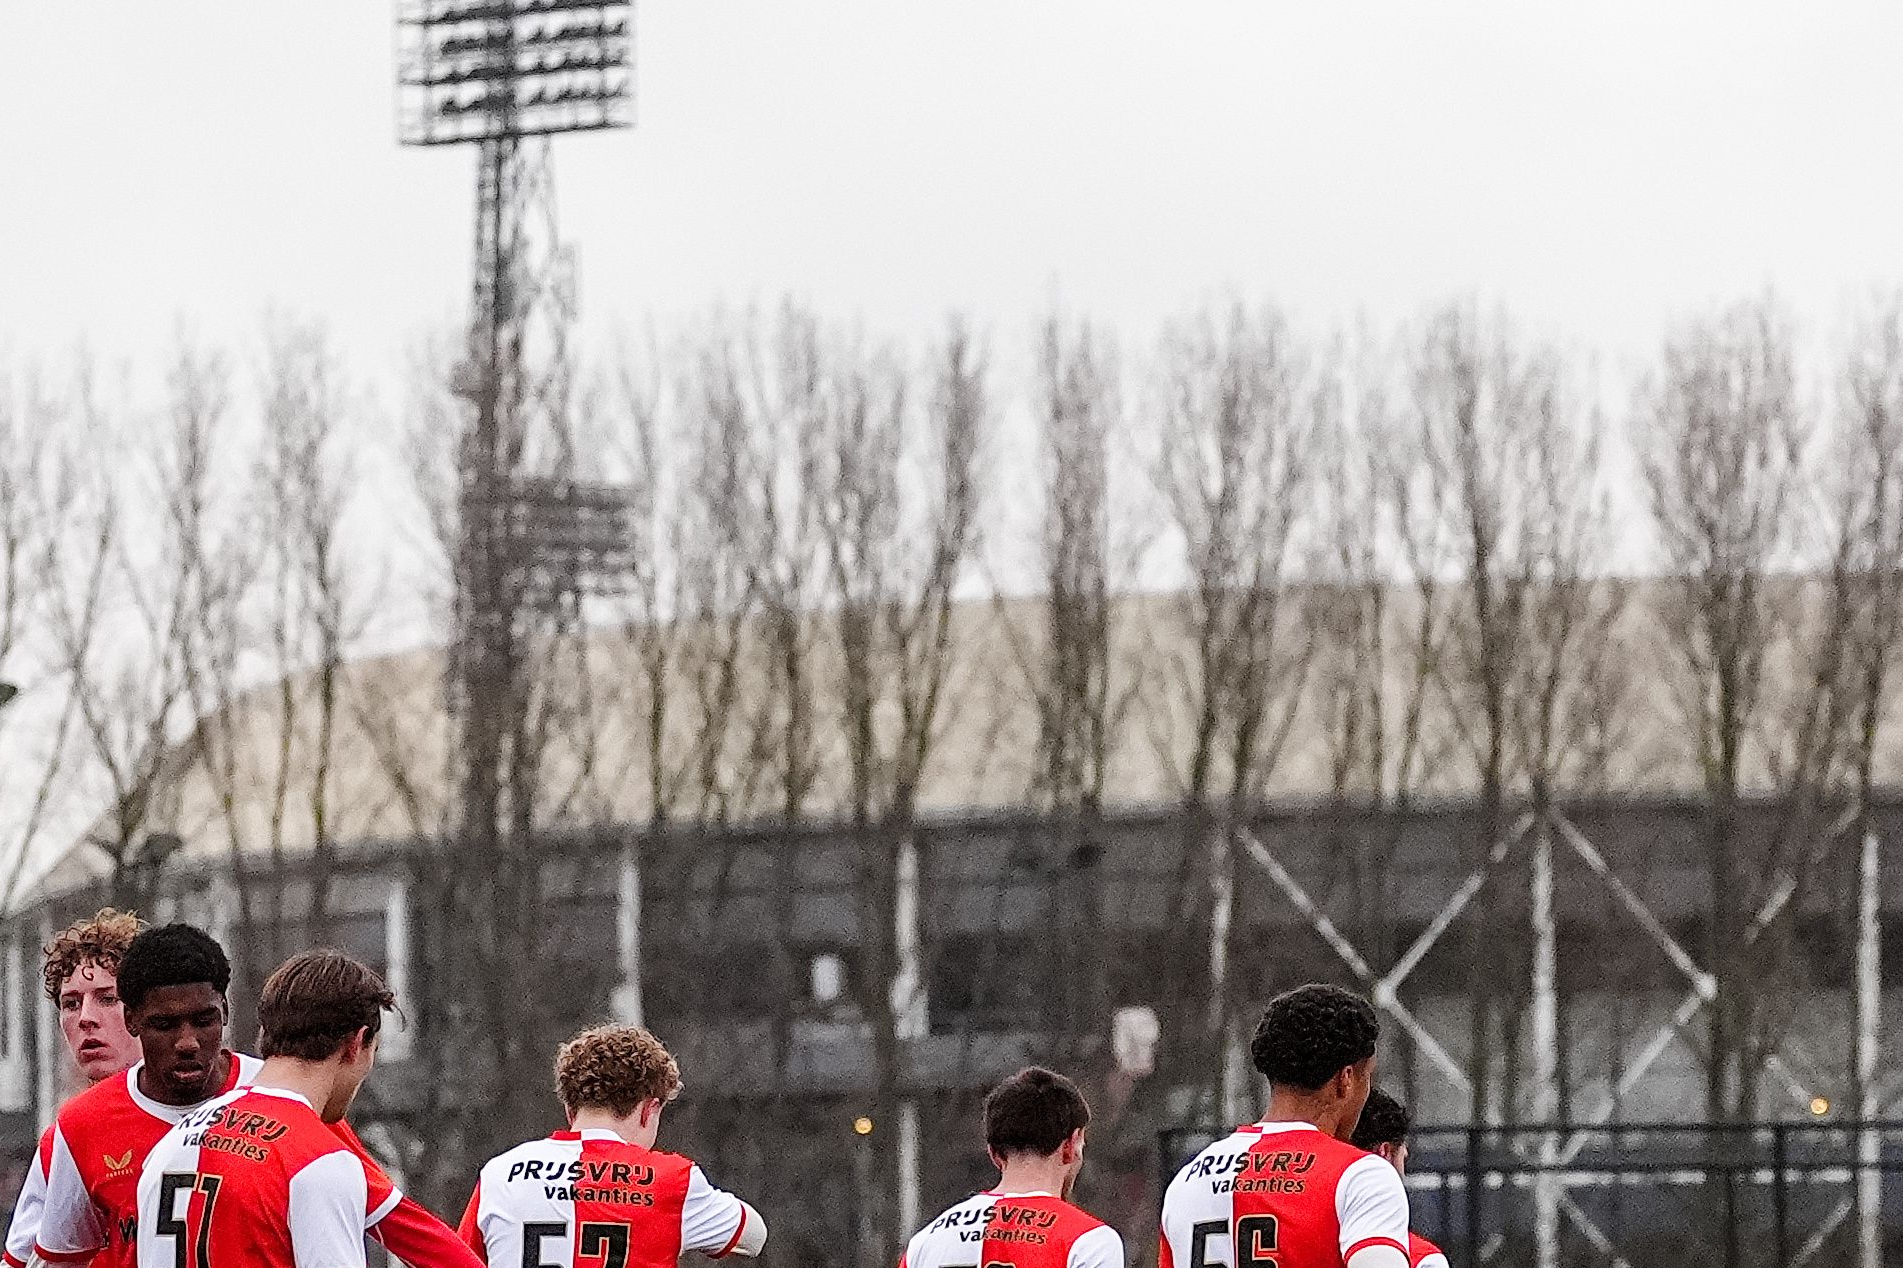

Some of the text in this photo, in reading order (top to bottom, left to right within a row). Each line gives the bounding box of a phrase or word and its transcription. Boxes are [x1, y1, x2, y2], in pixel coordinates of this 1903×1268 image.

[177, 1104, 290, 1143] RIJSVRIJ
[182, 1129, 268, 1162] vakanties
[544, 1184, 655, 1207] vakanties
[1212, 1175, 1305, 1195] vakanties
[959, 1226, 1048, 1245] vakanties
